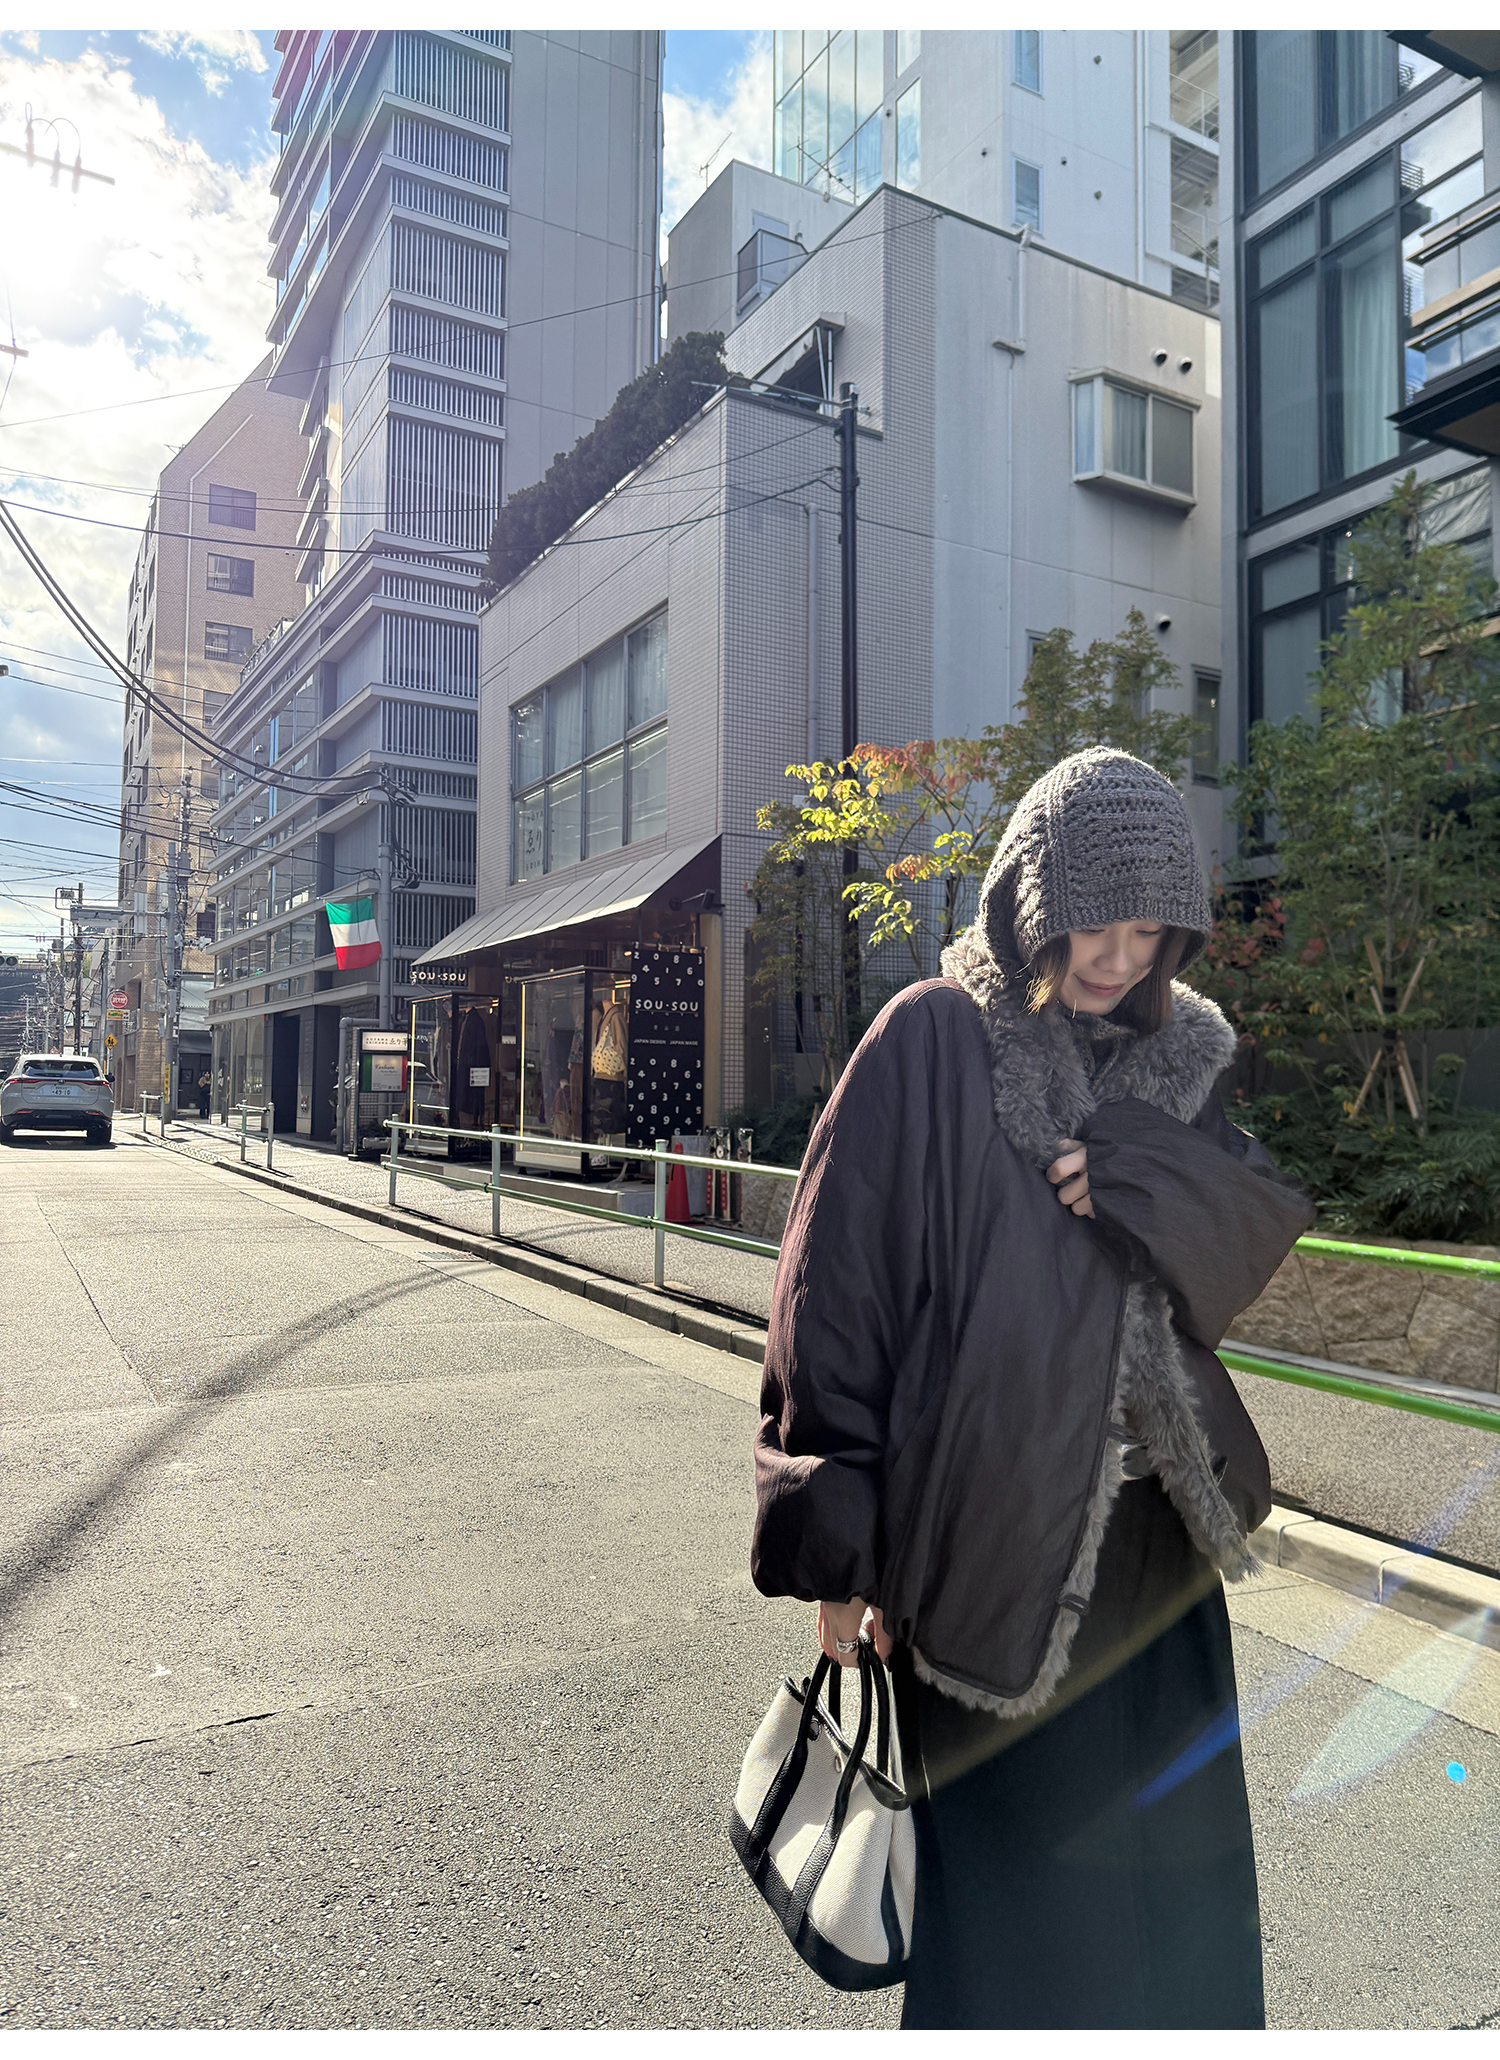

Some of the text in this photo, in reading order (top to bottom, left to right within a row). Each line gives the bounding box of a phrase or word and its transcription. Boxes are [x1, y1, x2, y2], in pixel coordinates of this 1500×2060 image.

[634, 951, 640, 959] 2
[673, 955, 680, 964] 8
[698, 956, 703, 965] 3
[642, 964, 650, 973] 4
[687, 967, 693, 975] 6
[631, 974, 637, 982] 9
[654, 977, 660, 985] 5
[675, 978, 681, 986] 7
[649, 1058, 656, 1066] 0
[671, 1059, 677, 1068] 8
[696, 1060, 701, 1068] 3
[638, 1070, 646, 1078] 4
[684, 1070, 691, 1078] 6
[628, 1080, 634, 1088] 9
[651, 1082, 657, 1090] 5
[673, 1082, 679, 1090] 7
[638, 1092, 691, 1101] 6 3 2
[650, 1105, 657, 1114] 8
[696, 1106, 701, 1114] 5
[637, 1115, 692, 1125] 0 9 4
[650, 1126, 656, 1134] 2
[638, 1139, 643, 1148] 3
